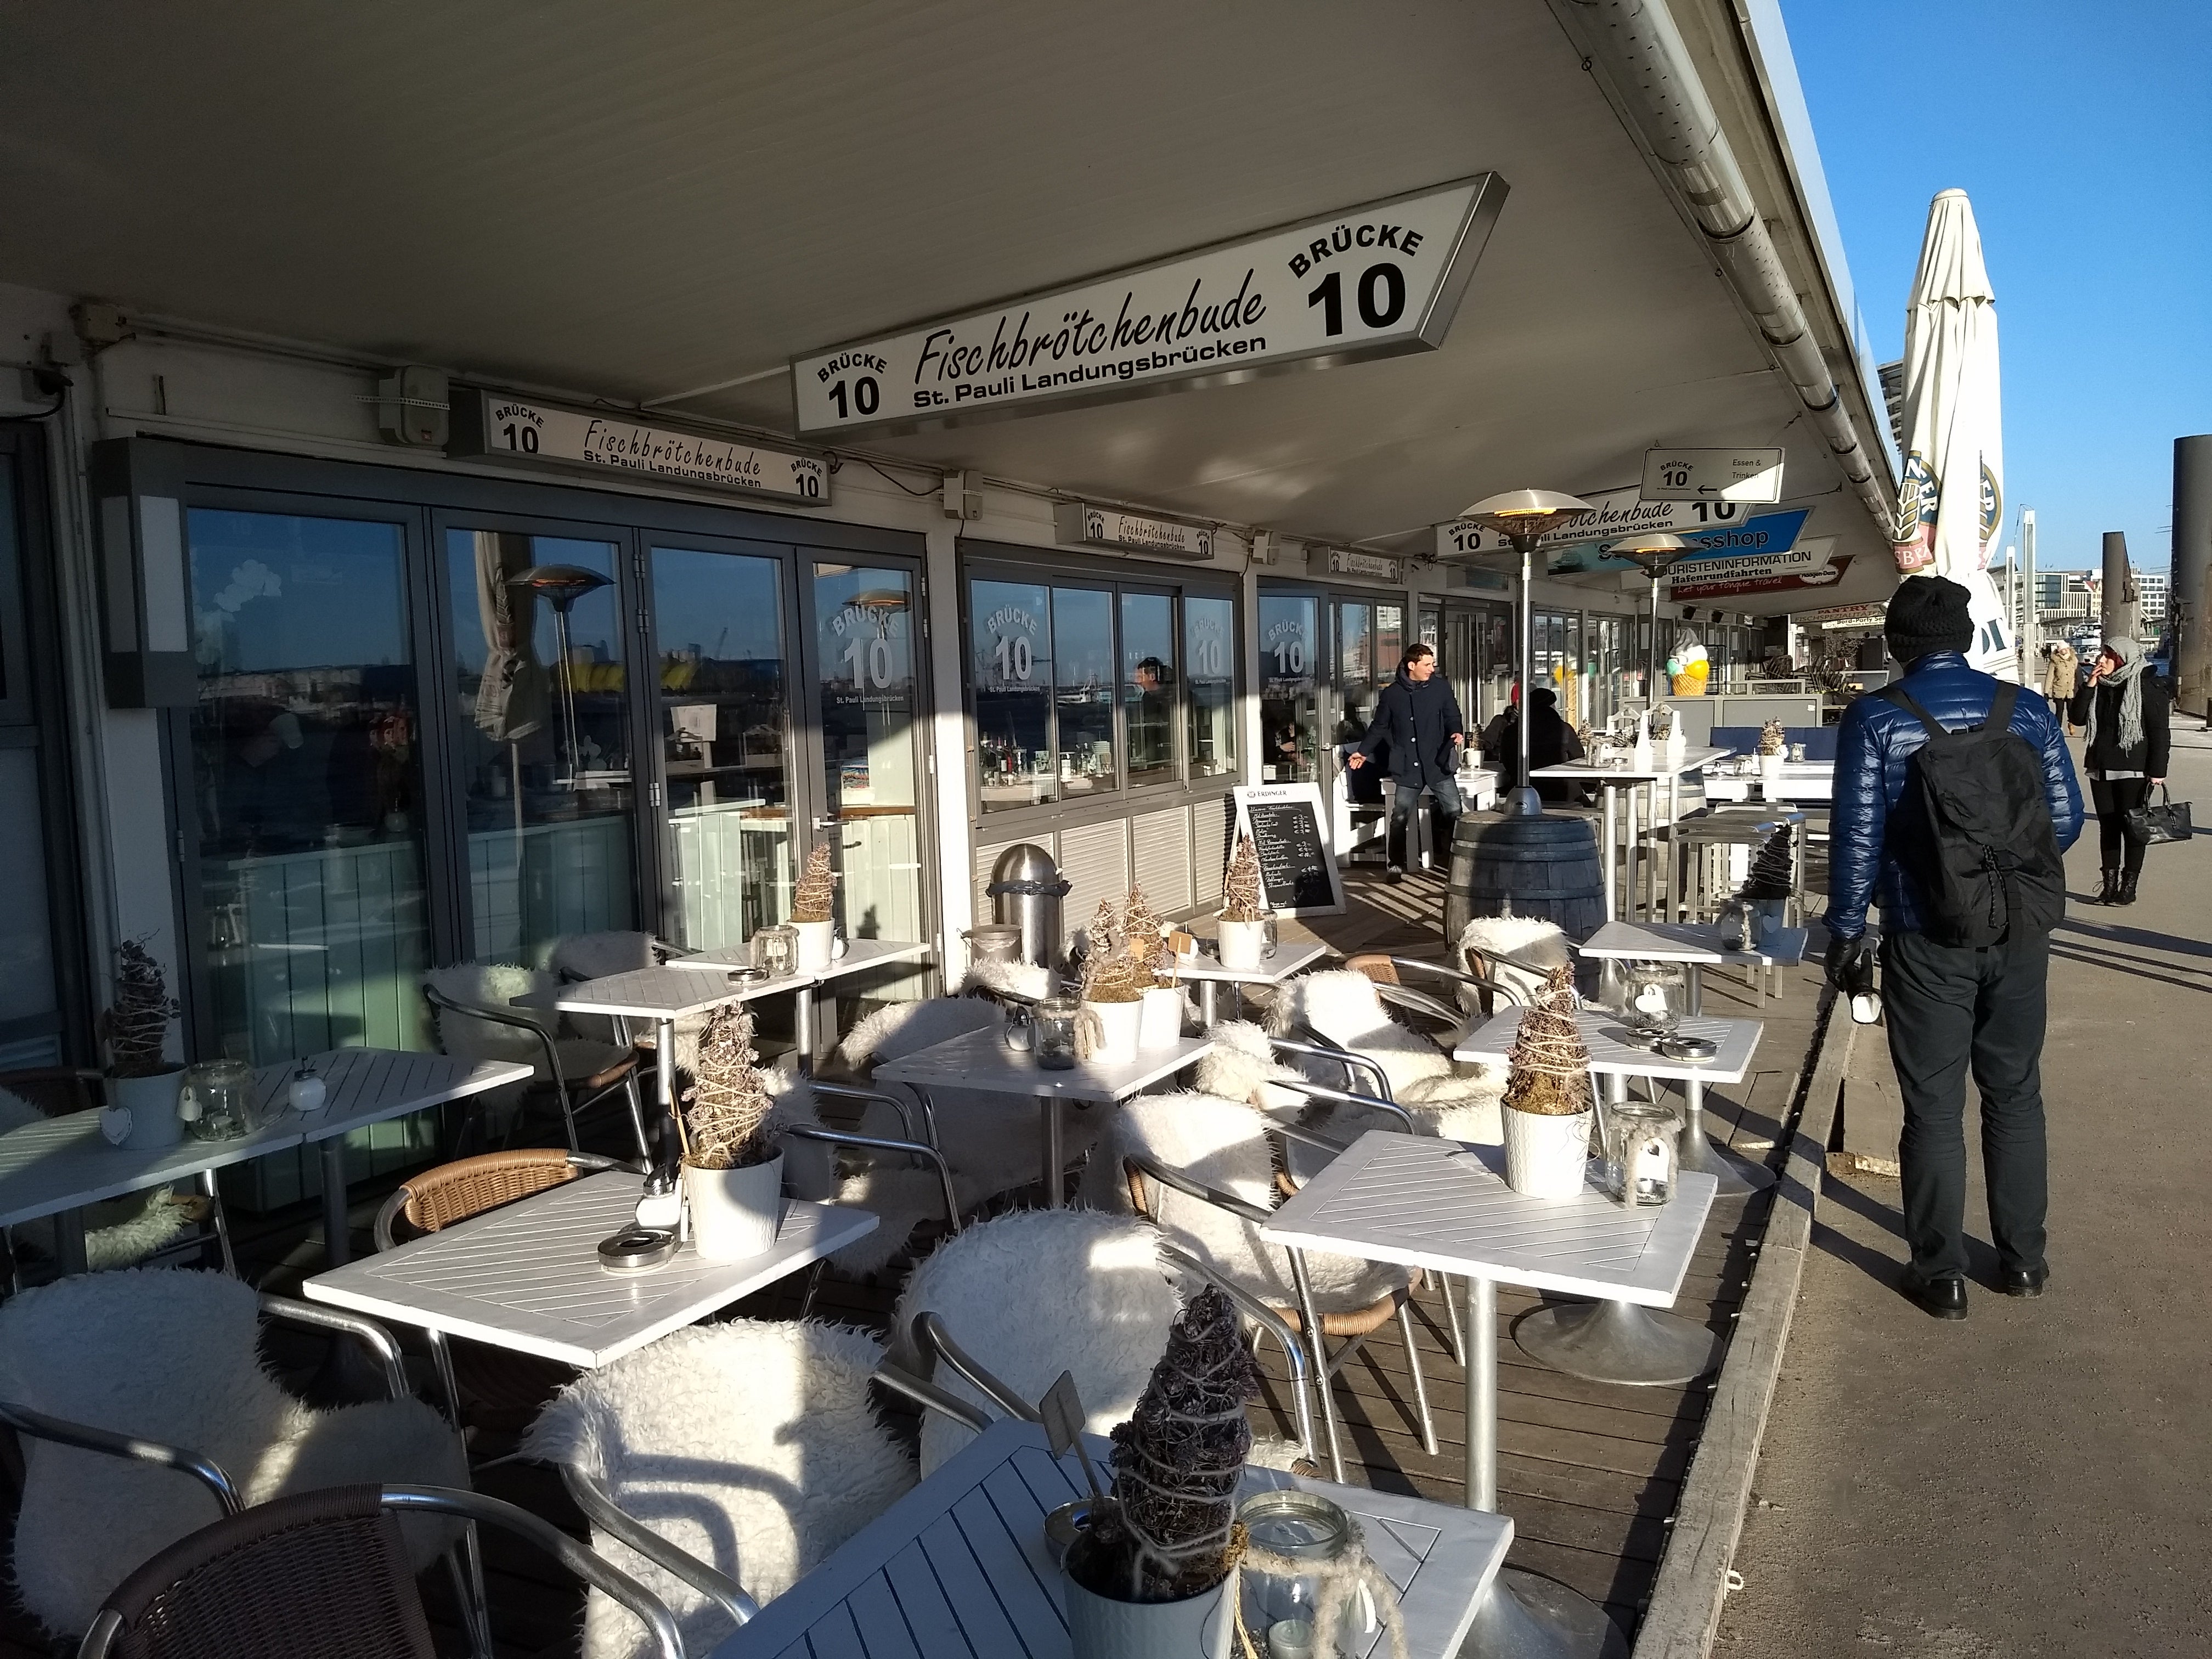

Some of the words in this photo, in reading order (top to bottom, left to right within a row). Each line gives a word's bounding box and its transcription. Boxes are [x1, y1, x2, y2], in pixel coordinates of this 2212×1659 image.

[1288, 224, 1424, 279] BRÜCKE
[1308, 262, 1406, 337] 10
[914, 268, 1267, 385] Fischbrötchenbude
[817, 352, 888, 383] BRÜCKE
[913, 390, 949, 408] St.
[955, 372, 1015, 402] Pauli
[1022, 336, 1266, 391] Landungsbrücken
[828, 376, 879, 419] 10
[495, 403, 545, 428] BRÜCKE
[503, 422, 539, 454] 10
[584, 420, 761, 475] Fischbrötchenbude
[583, 450, 606, 463] St.
[610, 454, 645, 470] Pauli
[649, 461, 761, 488] Landungsbrücken
[791, 458, 822, 477] BRÜCKE
[1663, 471, 1688, 487] 10
[795, 473, 819, 498] 10
[1692, 503, 1735, 522] 10
[1090, 522, 1103, 539] 10
[1448, 522, 1485, 536] BRÜCKE
[1454, 533, 1481, 551] 10
[1553, 520, 1673, 540] Landungsbrücken
[1199, 539, 1209, 554] 10
[1671, 567, 1773, 584] Hafenrundfahrten
[1696, 584, 1716, 594] your
[832, 601, 899, 638] BRÜCKE
[988, 604, 1037, 636] BRÜCKE
[1818, 604, 1870, 614] PANTRY
[844, 637, 893, 689] 10
[996, 636, 1031, 680] 10
[1199, 640, 1221, 676] 10
[1274, 641, 1304, 673] 10
